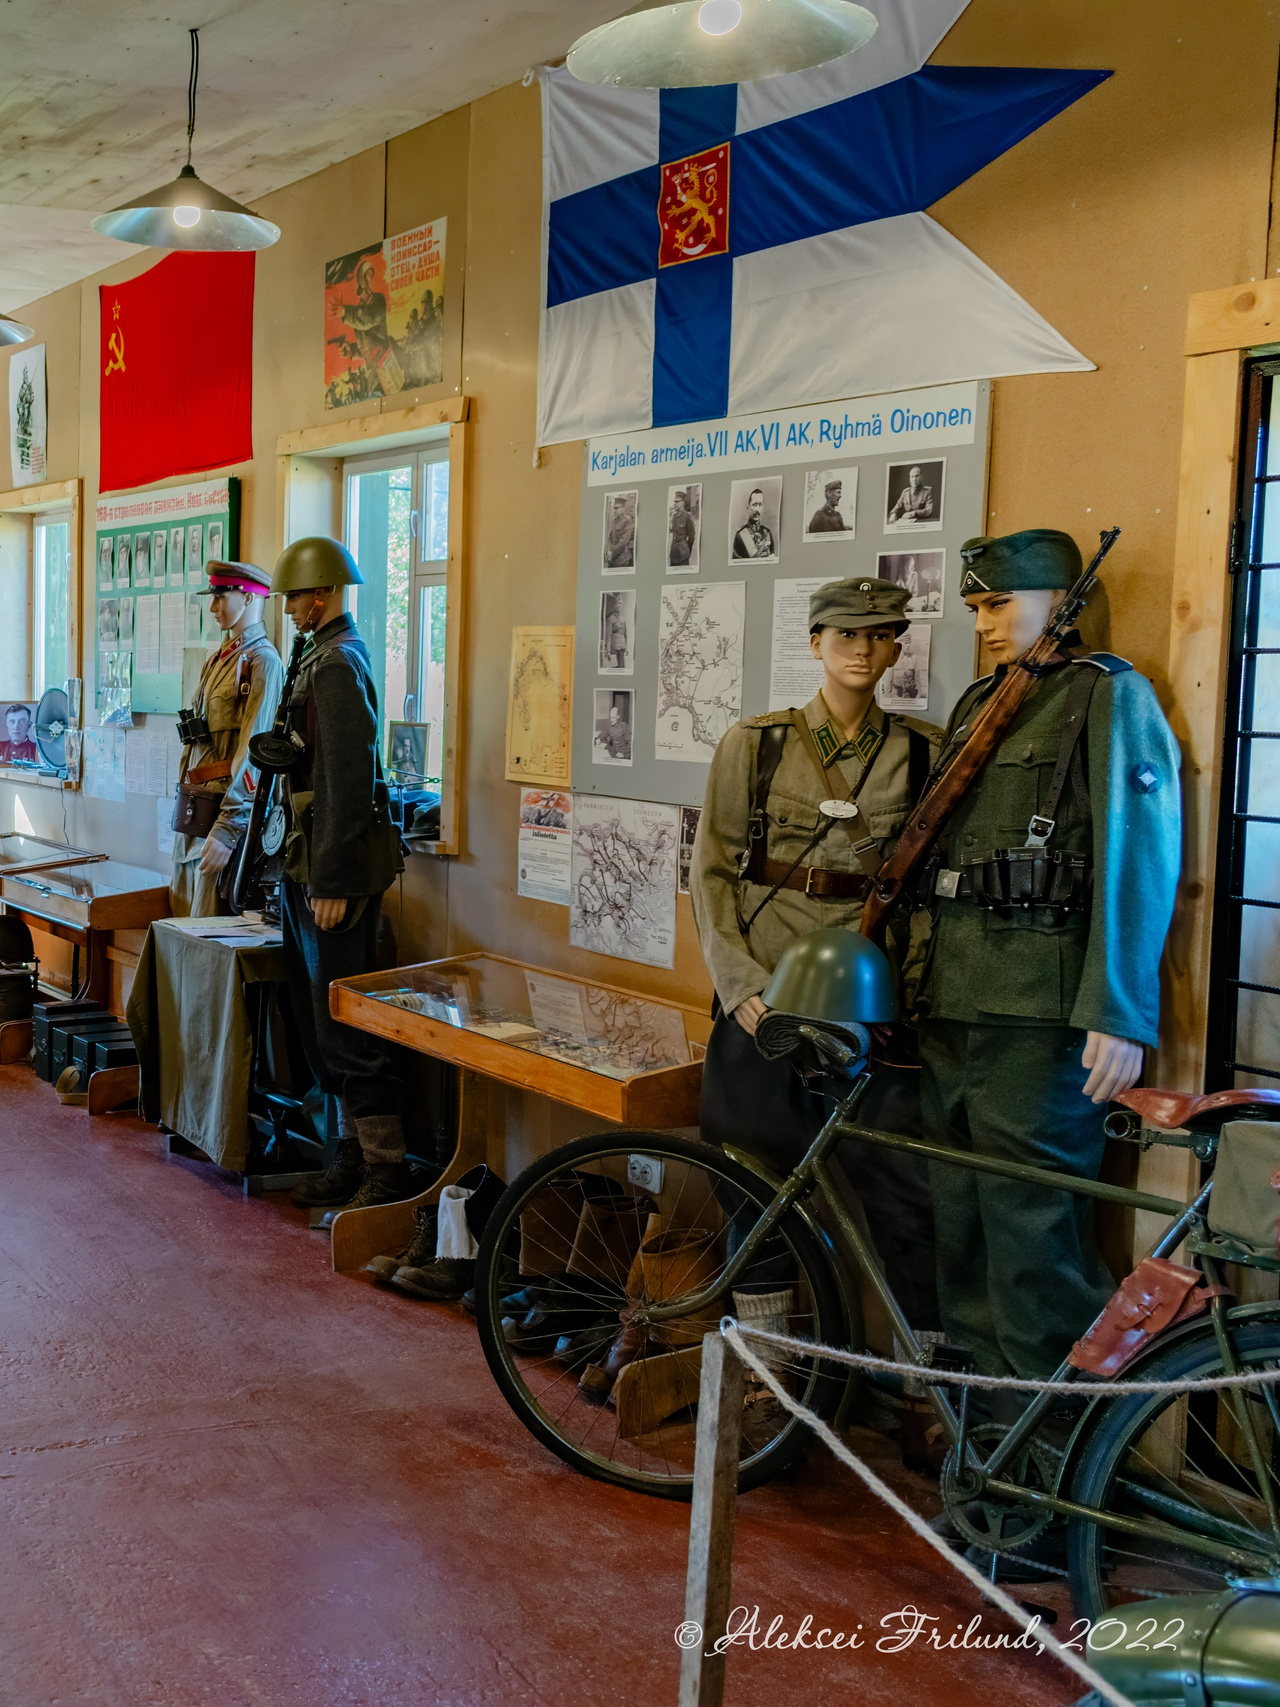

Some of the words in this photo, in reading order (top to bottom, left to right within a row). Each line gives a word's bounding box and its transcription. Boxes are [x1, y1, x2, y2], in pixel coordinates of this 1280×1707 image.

[391, 224, 433, 251] ВОЕННЫЙ
[391, 261, 411, 278] ОТЕЦ
[418, 250, 440, 269] ДУША
[415, 264, 440, 282] ЧАСТИ
[592, 445, 645, 476] Karjalan
[819, 413, 882, 449] Ryhmä
[890, 407, 971, 433] Oinonen
